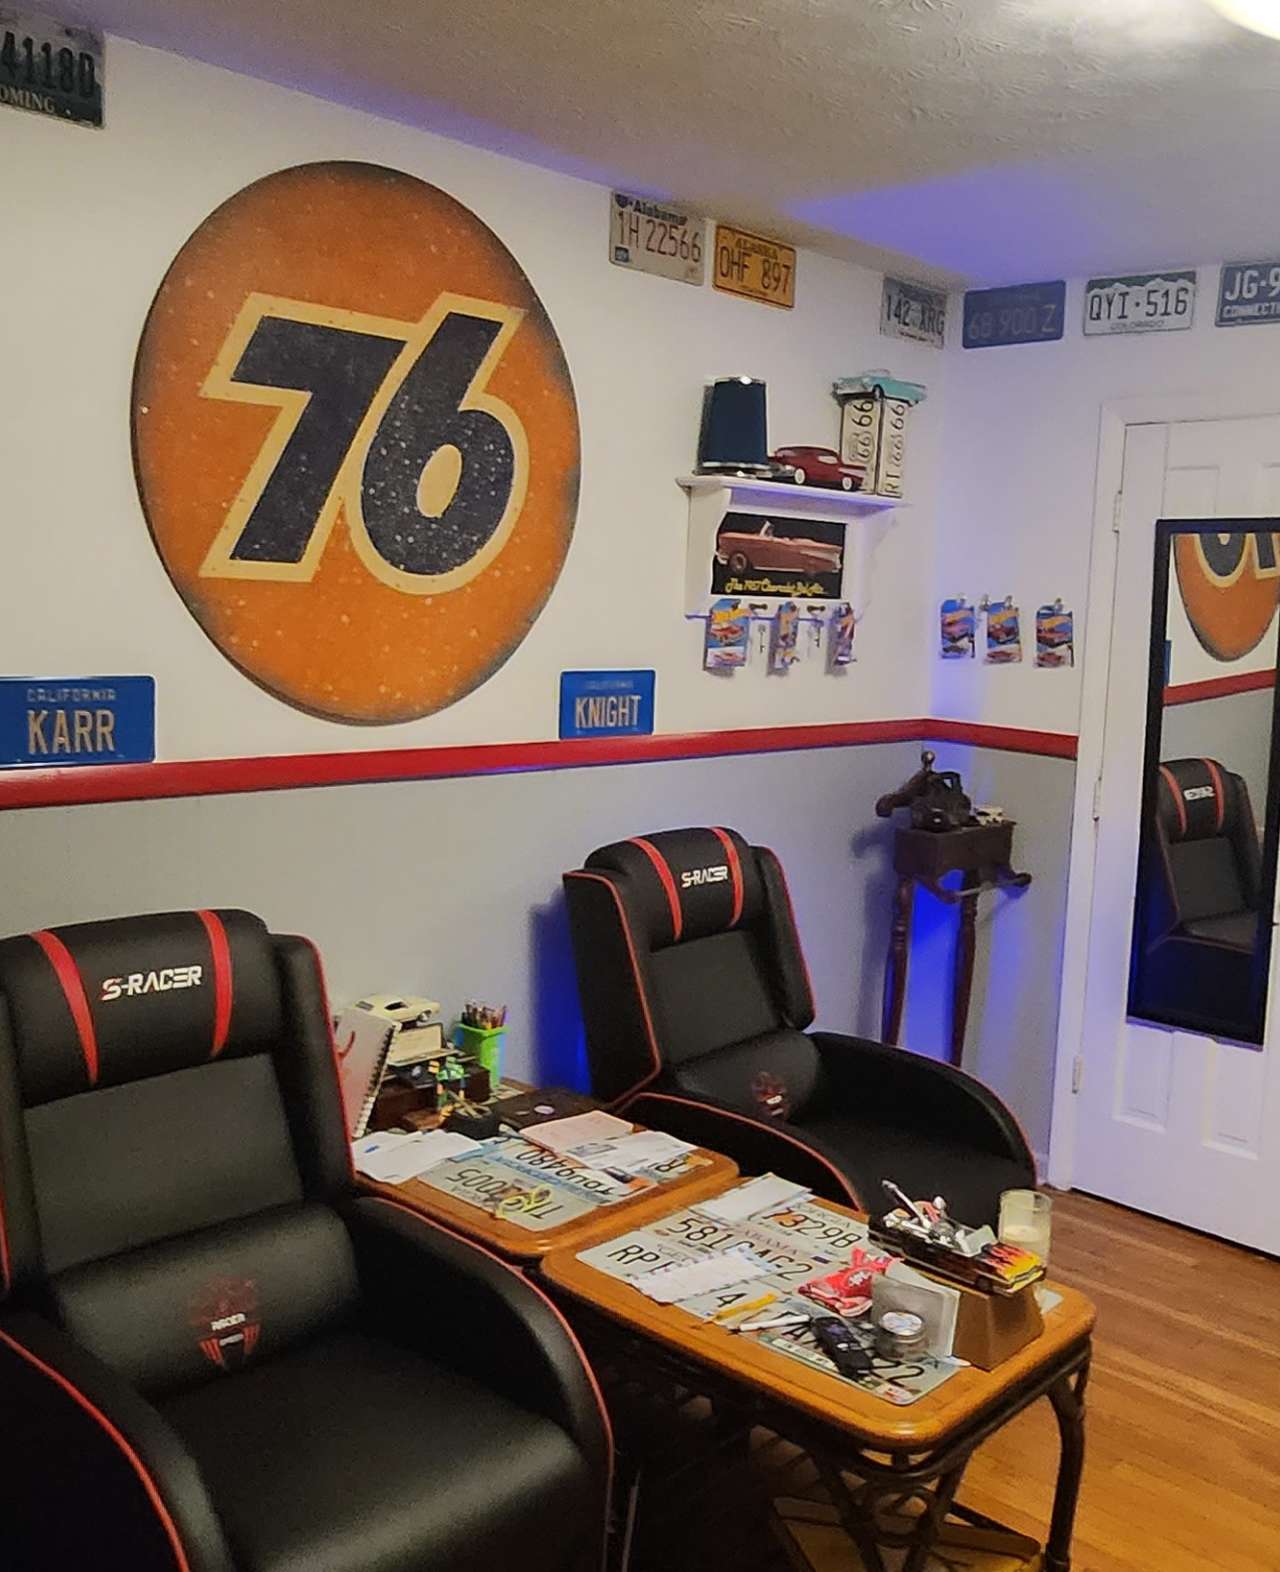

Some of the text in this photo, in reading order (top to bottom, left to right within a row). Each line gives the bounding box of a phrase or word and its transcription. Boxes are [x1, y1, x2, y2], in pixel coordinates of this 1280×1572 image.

[646, 219, 702, 263] 22566
[760, 258, 792, 294] 897
[1040, 303, 1057, 333] Z
[198, 291, 528, 596] 76
[26, 688, 117, 703] CALIFORNIA
[575, 694, 642, 729] KNIGHT
[26, 709, 116, 755] KARR
[680, 865, 729, 889] S-RACER
[101, 965, 203, 1002] S-RACER
